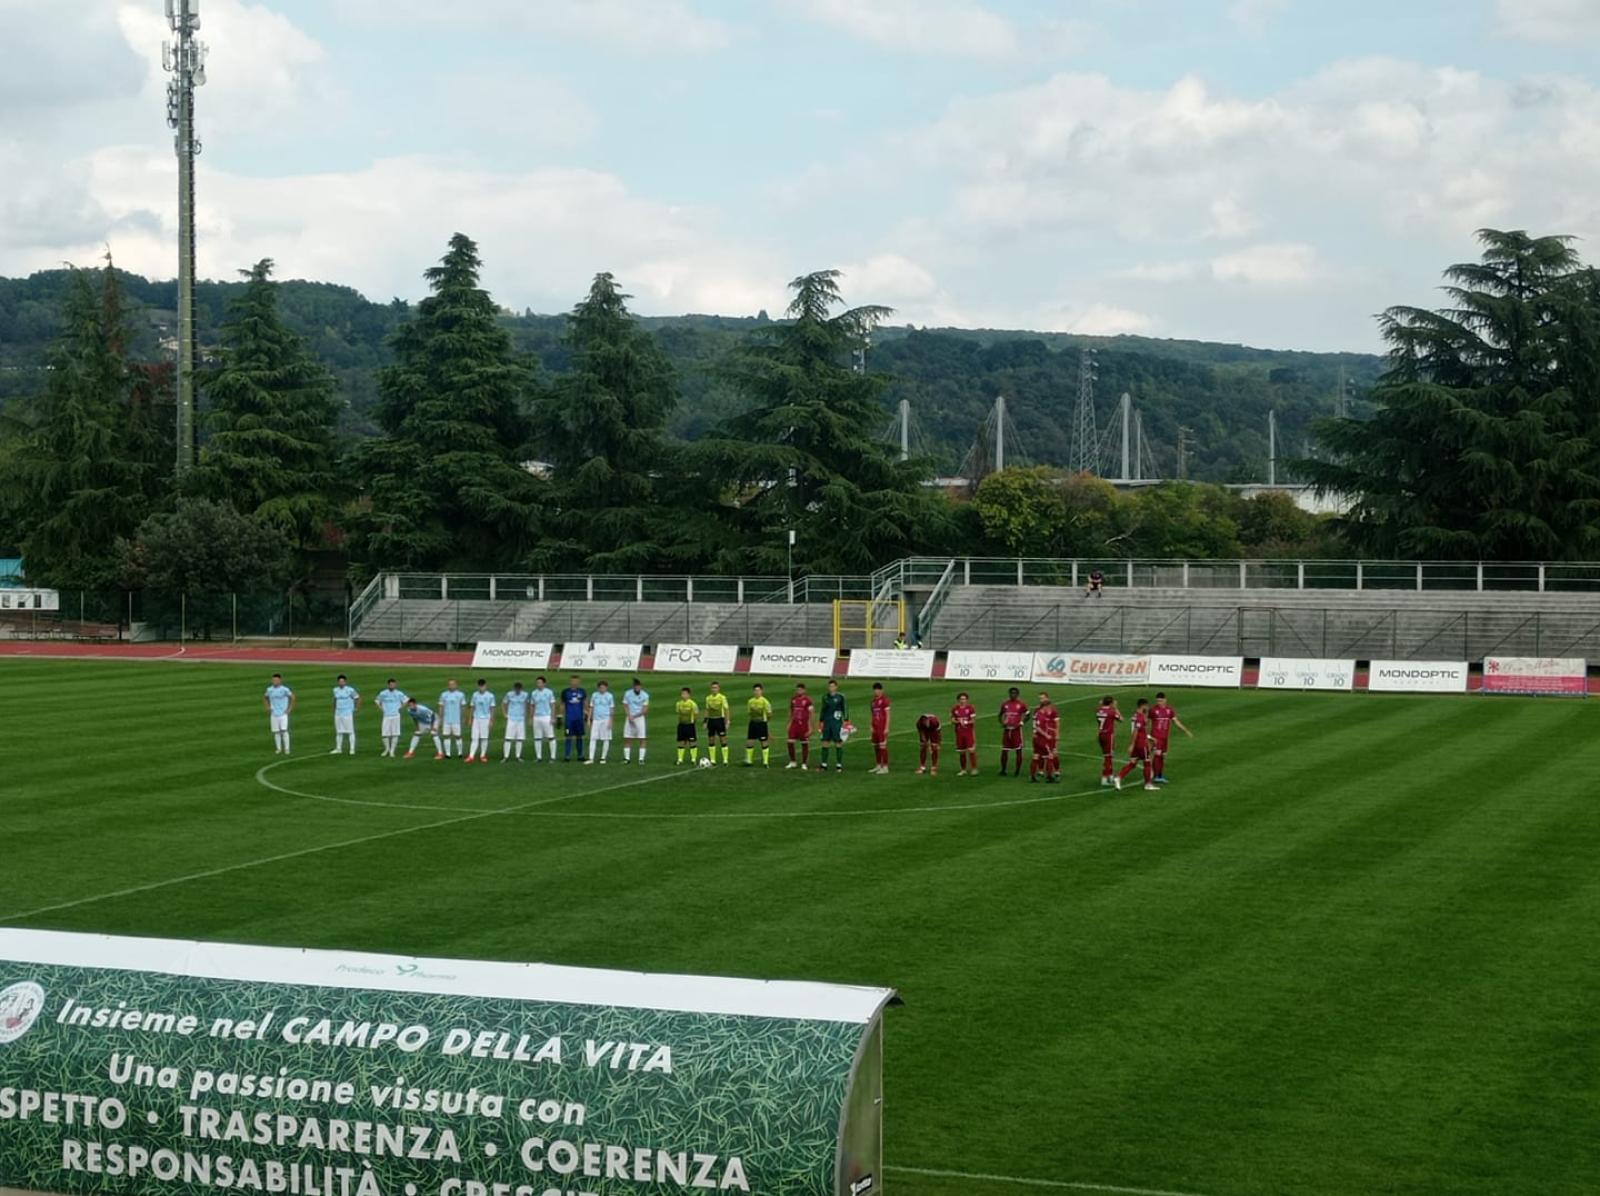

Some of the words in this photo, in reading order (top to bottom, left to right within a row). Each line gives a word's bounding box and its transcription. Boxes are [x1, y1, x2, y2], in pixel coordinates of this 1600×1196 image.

[481, 648, 545, 658] MONDOPTIC
[759, 653, 829, 664] MONDOPTIC
[1158, 663, 1235, 674] MONDOPTIC
[1378, 669, 1460, 679] MONDOPTIC
[56, 998, 198, 1035] Insieme
[210, 1012, 274, 1041] nel
[282, 1017, 430, 1052] CAMPO
[441, 1027, 563, 1065] DELLA
[585, 1038, 673, 1074] VITA
[109, 1053, 179, 1088] Una
[190, 1067, 354, 1106] passione
[371, 1076, 504, 1118] vissuta
[519, 1097, 586, 1127] con
[178, 1105, 461, 1163] TRASPARENZA
[521, 1137, 751, 1192] COERENZA
[62, 1138, 381, 1196] RESPONSABILITÀ
